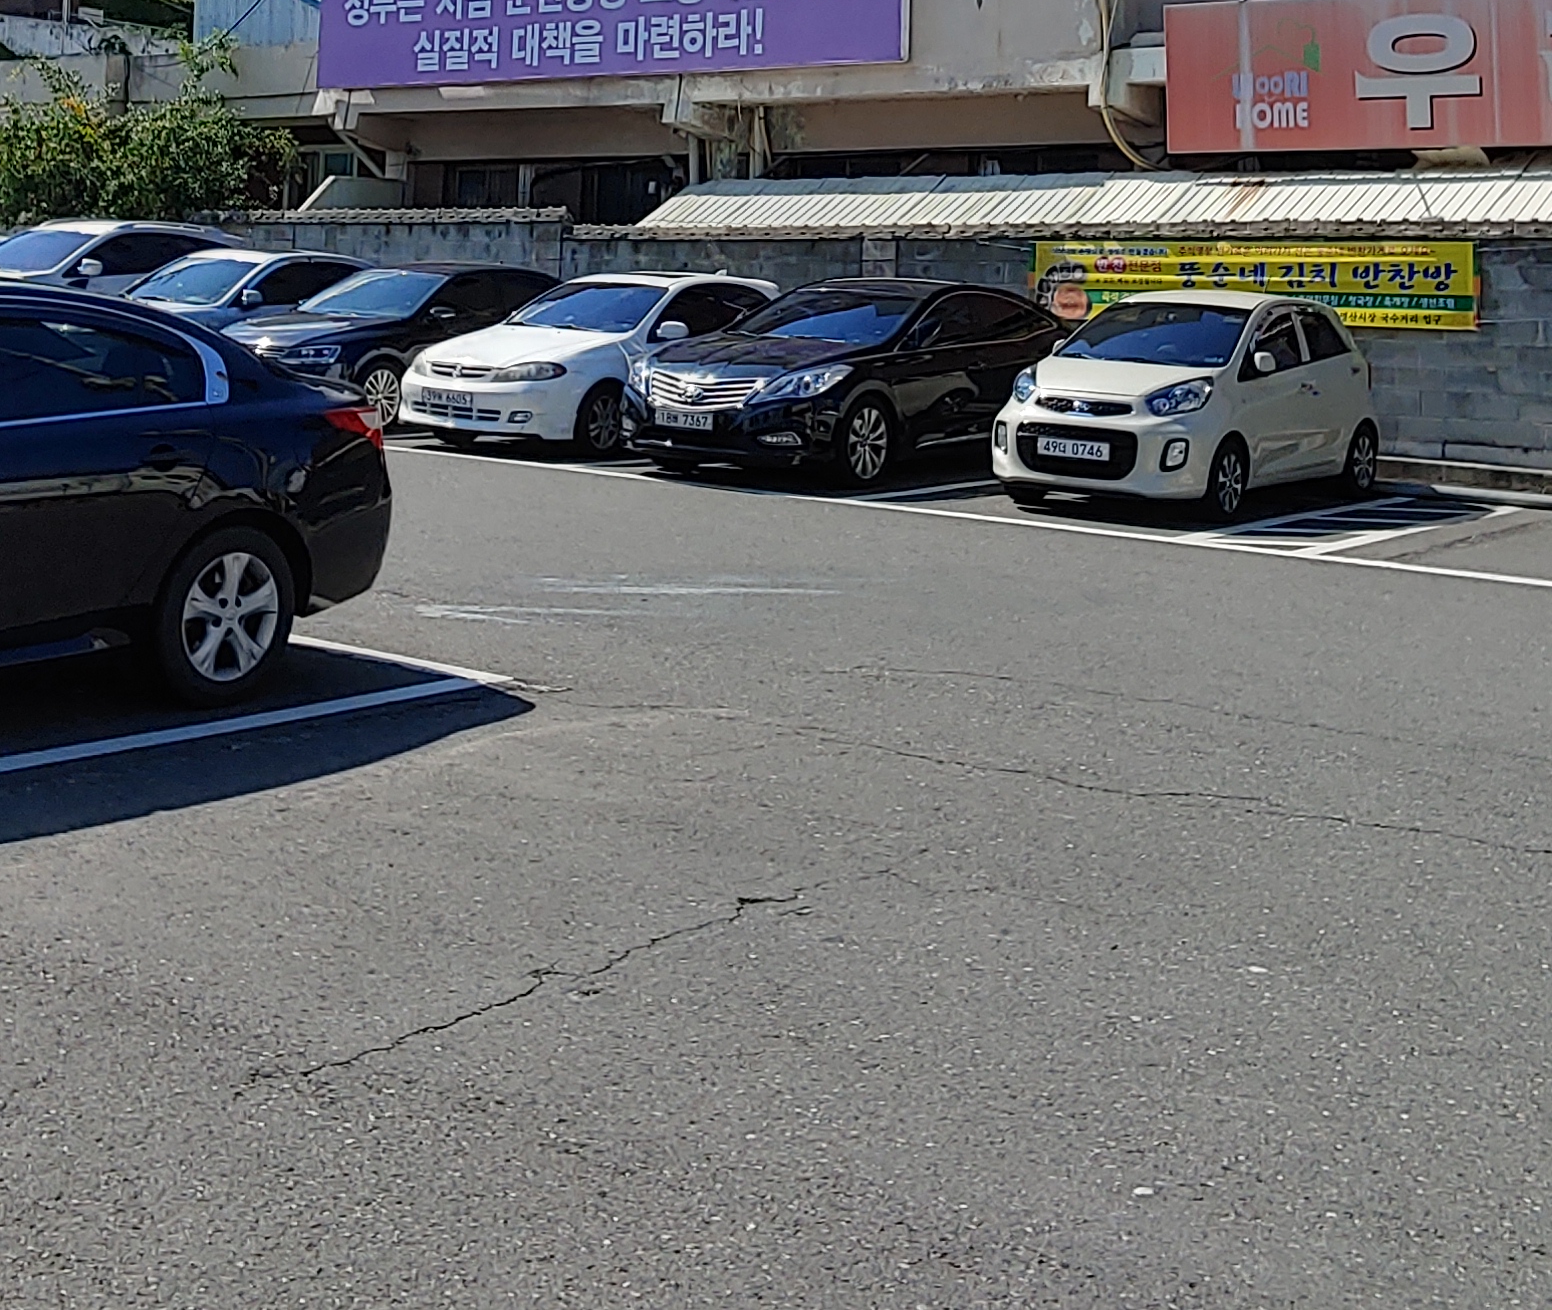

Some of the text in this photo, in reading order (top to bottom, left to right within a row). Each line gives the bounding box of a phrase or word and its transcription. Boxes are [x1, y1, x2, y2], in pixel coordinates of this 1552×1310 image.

[413, 8, 764, 72] 실질적 대책을 마련하라!
[1277, 262, 1337, 288] 김치
[1352, 262, 1458, 291] 반찬방
[1380, 313, 1418, 324] 국수거리
[1423, 314, 1444, 325] 입구
[1071, 442, 1103, 458] 0746
